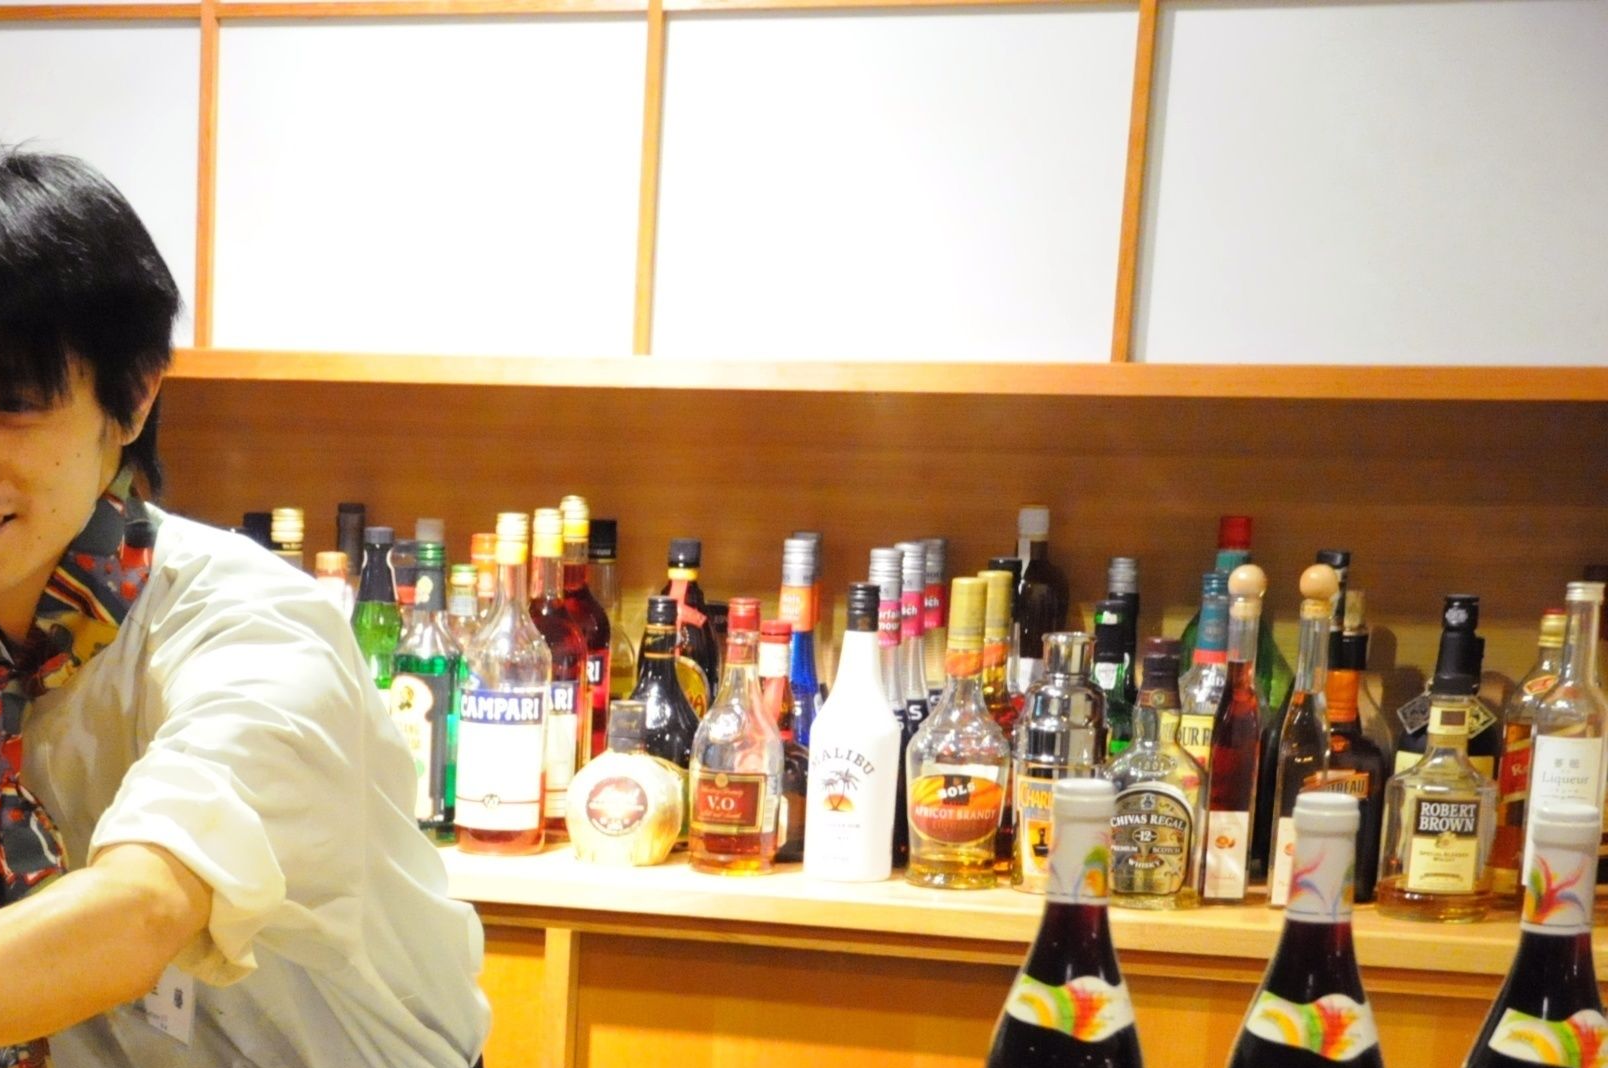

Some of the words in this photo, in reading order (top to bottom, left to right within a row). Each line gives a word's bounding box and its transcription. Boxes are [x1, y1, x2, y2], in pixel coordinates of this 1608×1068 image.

[460, 693, 540, 721] CAMPARI
[811, 746, 876, 776] MALIBU
[1542, 770, 1590, 786] Liqueur
[936, 782, 977, 800] BOLS
[1020, 782, 1050, 809] CHAR
[914, 805, 954, 819] APRICOT
[956, 808, 997, 820] BRANDY
[1420, 801, 1477, 818] ROBERT
[1110, 813, 1148, 828] CHIVAS
[1149, 814, 1185, 831] REGAL
[1418, 816, 1475, 832] BROWN
[1139, 829, 1152, 842] 12
